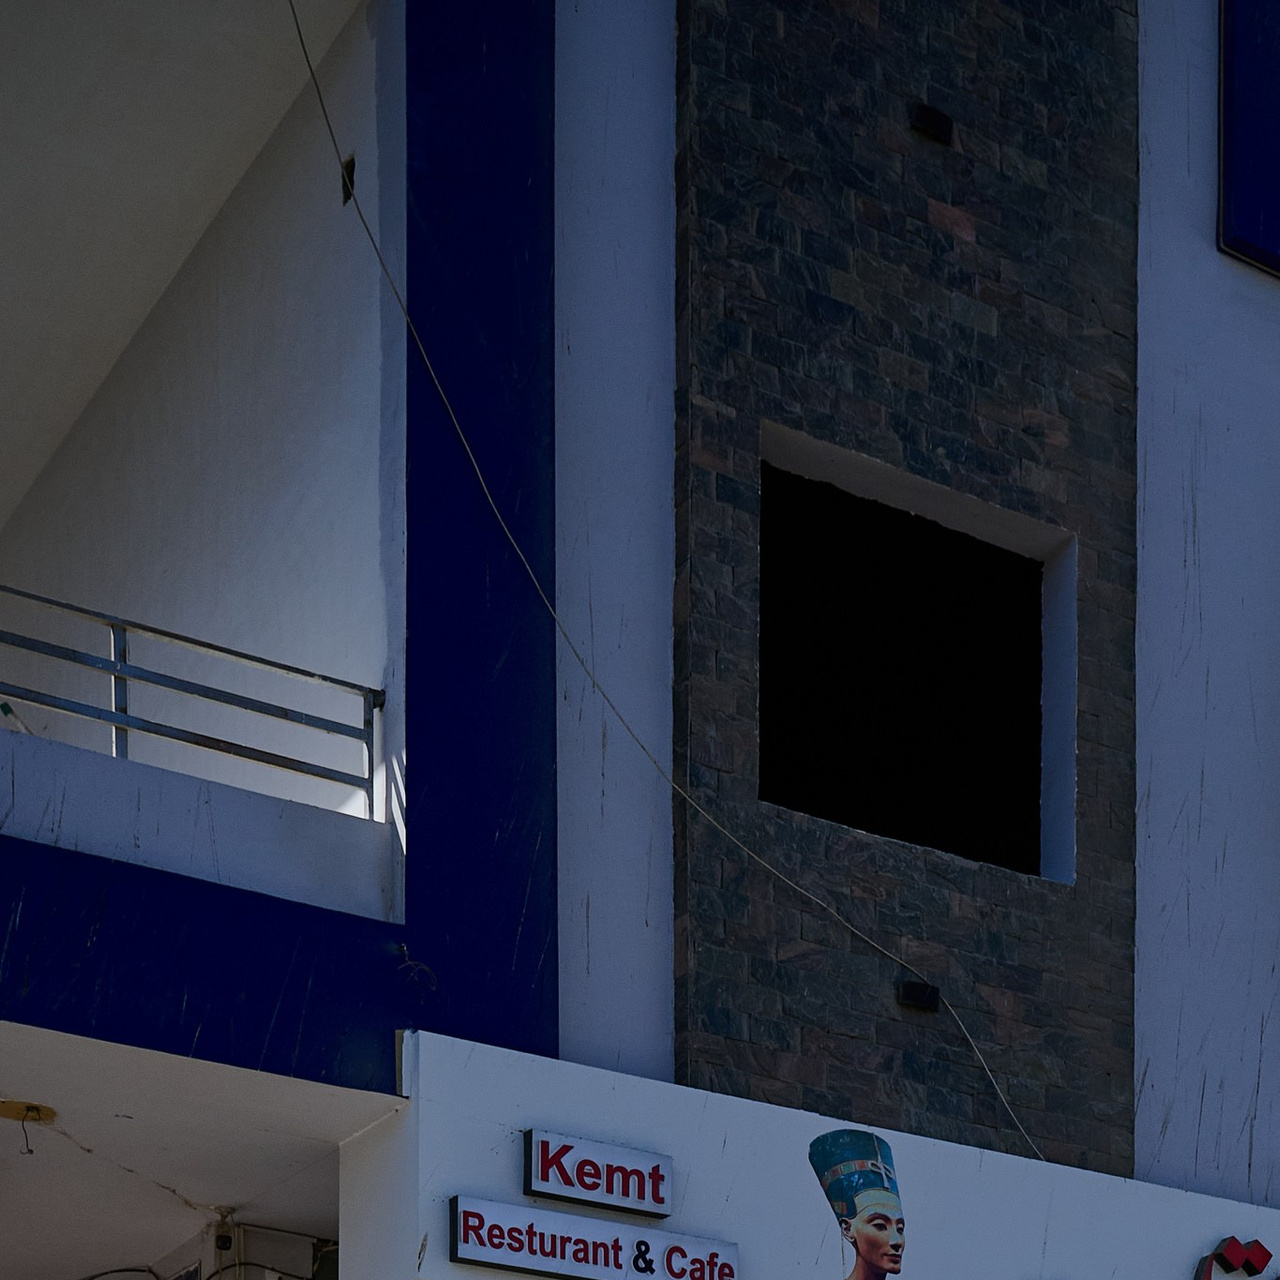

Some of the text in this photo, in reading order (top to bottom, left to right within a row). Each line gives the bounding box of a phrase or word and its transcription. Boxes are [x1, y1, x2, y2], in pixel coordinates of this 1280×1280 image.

[538, 1139, 666, 1205] Kemt
[461, 1209, 623, 1270] Resturant
[632, 1239, 656, 1275] &
